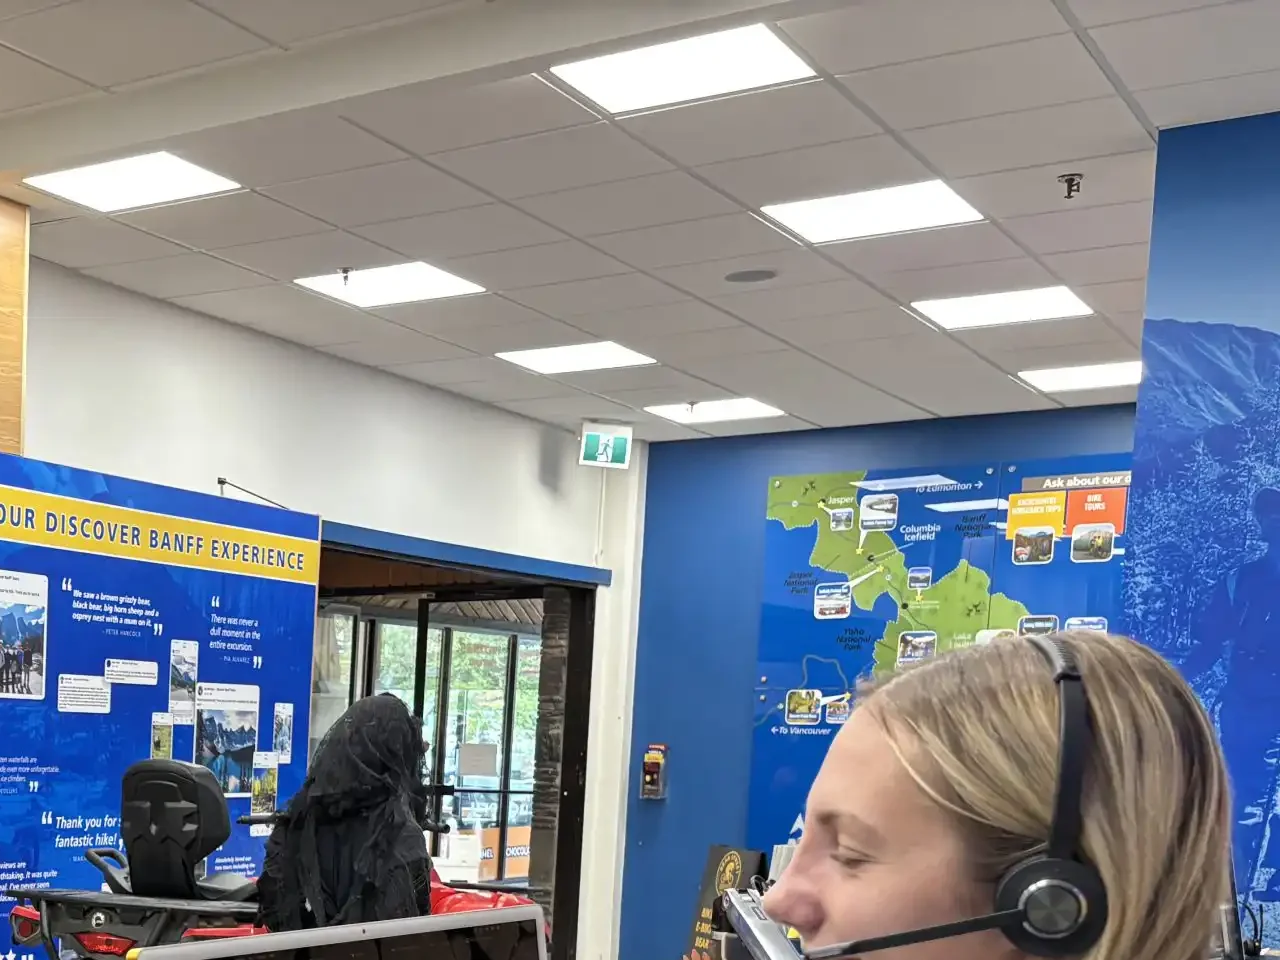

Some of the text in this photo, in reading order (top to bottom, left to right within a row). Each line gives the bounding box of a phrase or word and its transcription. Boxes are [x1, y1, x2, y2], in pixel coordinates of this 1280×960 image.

[926, 482, 972, 492] Edmonton
[1043, 478, 1064, 488] Ask
[1066, 476, 1099, 487] about
[1102, 476, 1123, 484] our
[828, 496, 854, 506] Jasper
[1086, 493, 1102, 502] BIKE
[1084, 502, 1106, 511] TOURS
[900, 522, 941, 534] Columbia
[46, 512, 141, 546] DISCOVER
[149, 528, 204, 556] BANFF
[211, 539, 305, 570] EXPERIENCE
[904, 532, 936, 541] Icefield
[72, 589, 82, 598] We
[83, 591, 96, 600] saw
[100, 592, 119, 602] brown
[120, 594, 138, 606] grizzly
[72, 600, 88, 610] black
[104, 602, 114, 614] big
[114, 604, 127, 614] horn
[128, 606, 144, 617] sheep
[144, 608, 155, 616] and
[72, 612, 92, 623] osprey
[92, 614, 105, 622] nest
[106, 615, 119, 624] with
[124, 618, 138, 626] mum
[210, 614, 226, 624] There
[227, 617, 238, 626] was
[238, 618, 254, 627] never
[210, 626, 260, 640] dull moment in the
[209, 640, 226, 650] entire
[779, 726, 832, 735] To Vancouver
[8, 756, 30, 764] waterfalls
[56, 816, 83, 829] Thank
[84, 818, 102, 832] you
[104, 814, 118, 828] for
[55, 832, 118, 848] fantastic hike!
[42, 870, 58, 879] quite
